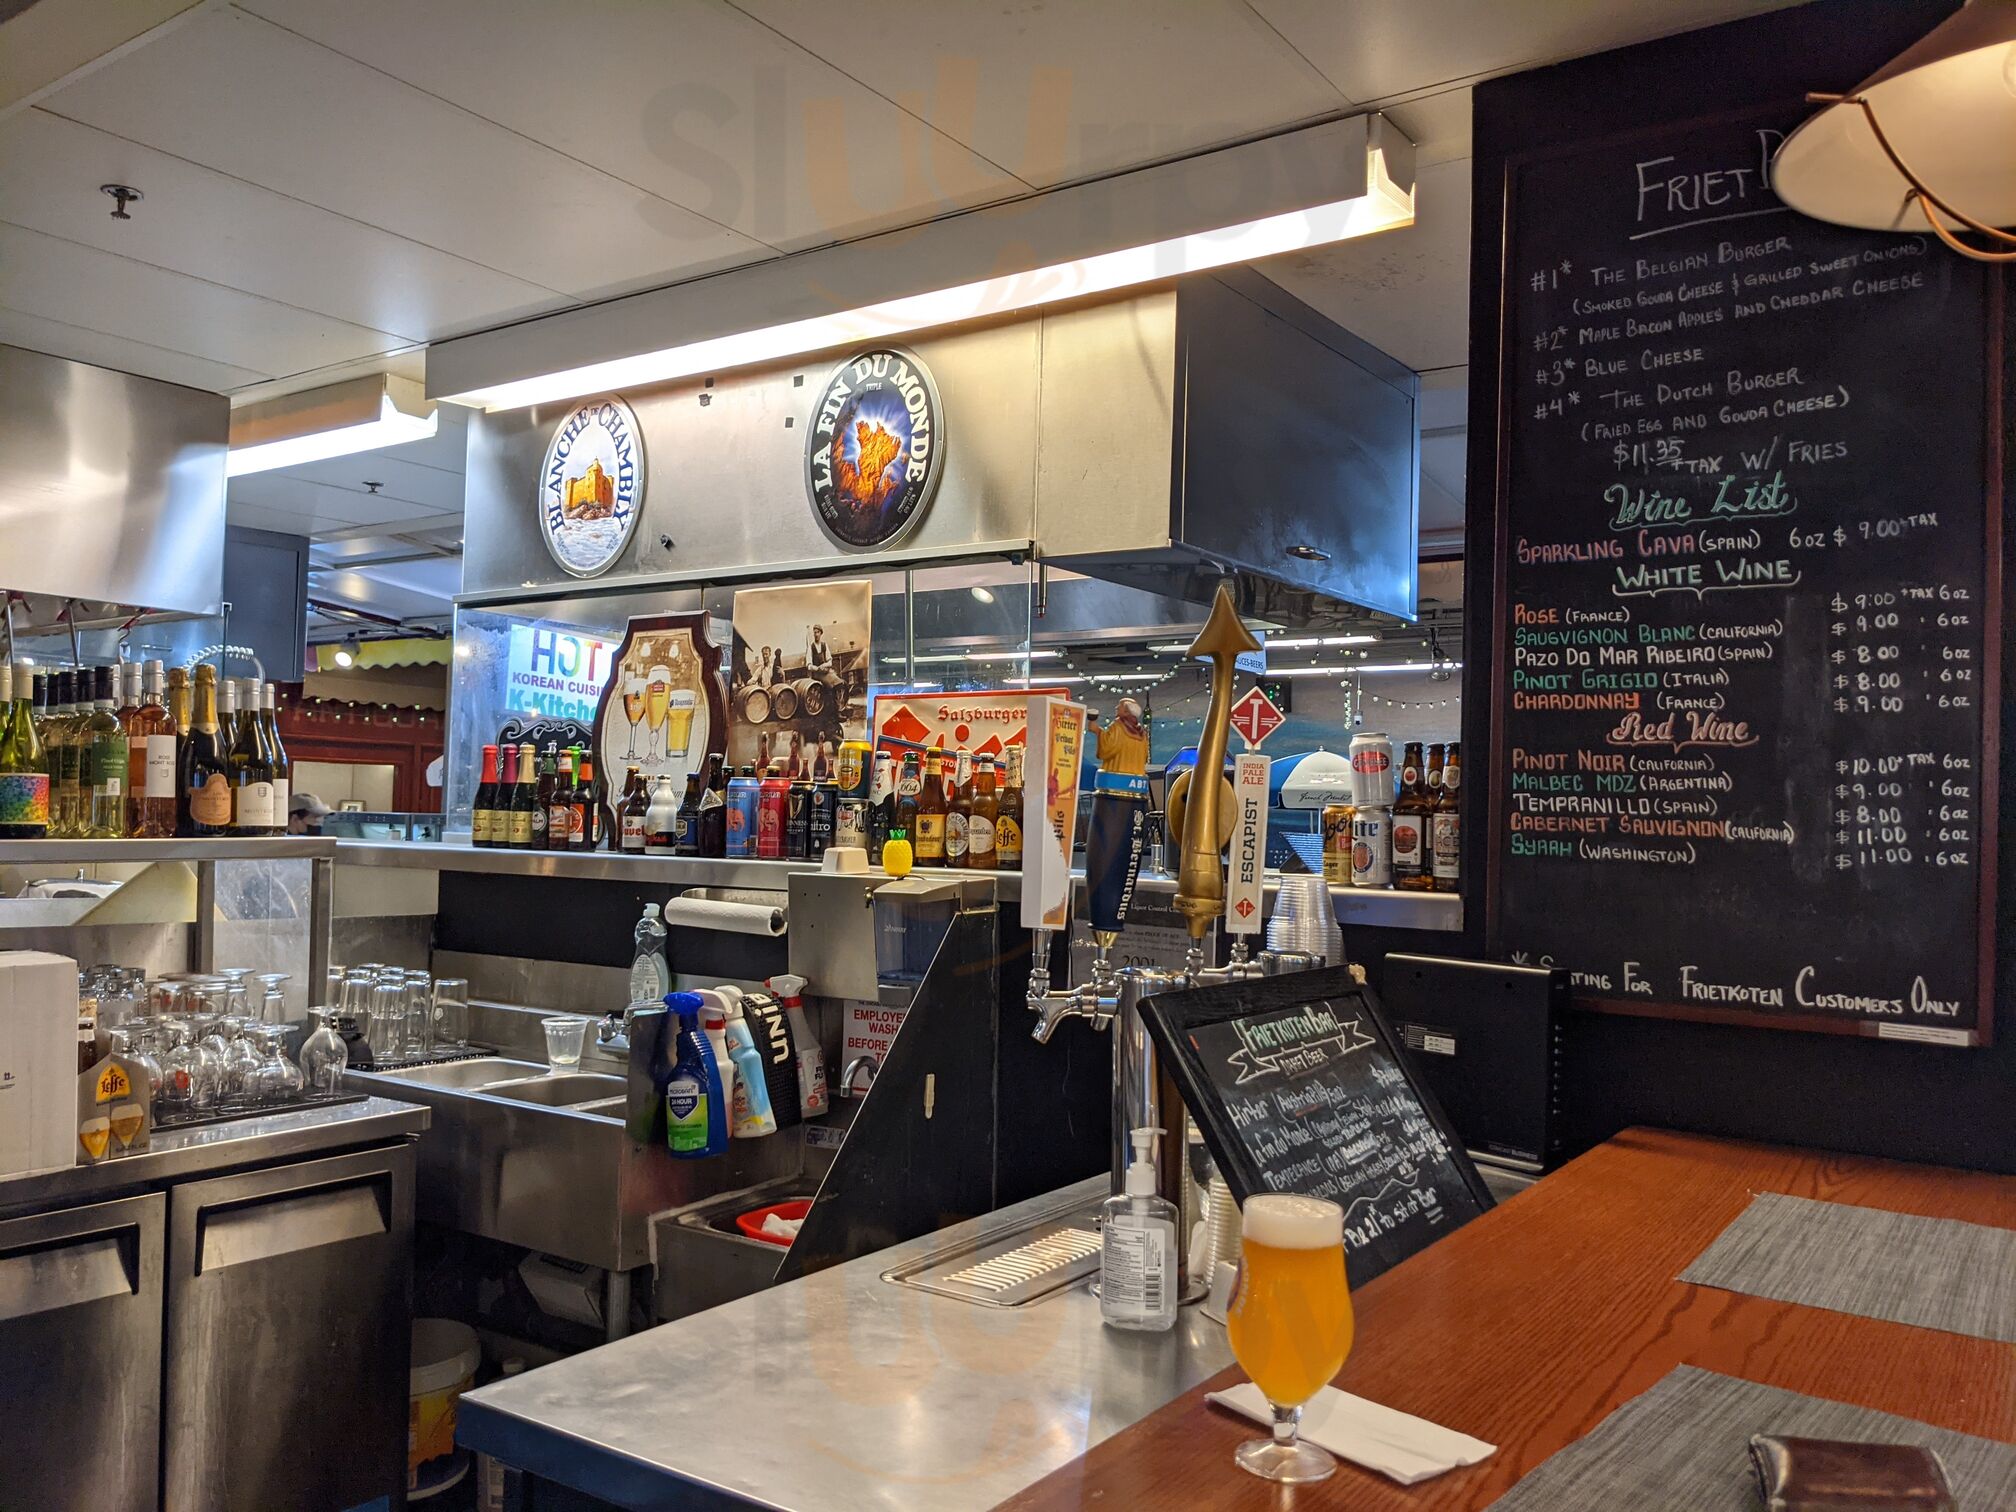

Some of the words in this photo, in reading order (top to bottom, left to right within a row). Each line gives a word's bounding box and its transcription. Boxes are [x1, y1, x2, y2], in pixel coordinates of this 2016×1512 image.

[1636, 156, 1753, 222] FRIET
[1591, 267, 1626, 286] THE
[1636, 252, 1709, 280] BELGIAN
[1717, 236, 1792, 264] BURGER
[1637, 291, 1674, 306] GOUDA
[1678, 281, 1724, 301] CHEESE
[1744, 266, 1802, 286] GRILLED
[1809, 254, 1859, 275] SWEET
[1579, 325, 1621, 345] MAPLE
[1625, 318, 1672, 338] BACON
[1678, 308, 1724, 328] APPLES
[1735, 304, 1766, 319] AND
[1770, 286, 1844, 310] CHEDDAR
[1853, 273, 1924, 296] CHEESE
[851, 354, 893, 385] DU
[1585, 358, 1629, 378] BLUE
[1641, 348, 1704, 371] CHEESE
[1599, 390, 1645, 409] THE
[1657, 382, 1713, 405] DUTCH
[1726, 367, 1804, 395] BURGER
[816, 377, 851, 436] FIN
[1637, 419, 1663, 434] EGG
[1672, 414, 1707, 431] AND
[1718, 405, 1768, 423] GOUDA
[890, 361, 930, 483] MONDE
[814, 442, 833, 493] LA
[1788, 441, 1848, 465] FRIES
[548, 406, 590, 535] BLANCHE
[598, 402, 634, 531] CHAMBLY
[1604, 484, 1693, 524] Wine
[1711, 470, 1789, 513] List
[1518, 538, 1624, 564] SPARKLING
[1638, 529, 1695, 556] CAVA
[1699, 529, 1761, 553] (SPAIN)
[1617, 563, 1702, 589] WHITE
[1715, 557, 1793, 584] WINE
[1514, 603, 1559, 624] ROSE
[1565, 605, 1631, 624] (FRANCE)
[1638, 624, 1696, 643] BLANC
[1699, 618, 1784, 640] (CALIFORNIA)
[531, 629, 603, 681] HOT
[1514, 647, 1559, 667] PAZO
[1566, 648, 1591, 666] DO
[1599, 647, 1638, 665] MAR
[1647, 646, 1716, 664] RIBEIRO
[1717, 641, 1773, 660] (SPAIN)
[512, 671, 565, 691] KOREAN
[1513, 670, 1572, 690] PINOT
[1582, 668, 1658, 689] GRIGIO
[1663, 668, 1730, 686] (ITALIA)
[937, 704, 1028, 724] Salzburger
[1513, 691, 1641, 711] CHARDONNAY
[1656, 692, 1725, 711] (FRANCE)
[1613, 713, 1675, 742] Red
[1686, 711, 1749, 742] Wine
[1243, 769, 1264, 777] PALE
[1512, 749, 1568, 771] PINOT
[1578, 753, 1625, 772] NOIR
[1629, 753, 1715, 772] (CALIFORNIA)
[1242, 776, 1264, 785] ALE
[1512, 773, 1583, 791] MALBEC
[1596, 774, 1637, 792] MDZ
[1639, 772, 1733, 792] (ARGENTINA)
[1513, 794, 1650, 815] TEMPRANILLO
[1653, 795, 1718, 816] (SPAIN)
[1510, 813, 1610, 833] CABERNET
[1619, 815, 1724, 838] SAUVIGNON
[1241, 797, 1258, 885] ESCAPIST
[1579, 838, 1696, 865] (WASHINGTON)
[1623, 962, 1653, 995] FOR
[1680, 965, 1783, 1007] FRIETKOTEN
[1795, 966, 1903, 1015] CUSTOMERS
[1911, 976, 1959, 1017] ONLY
[848, 1037, 888, 1051] BEFORE
